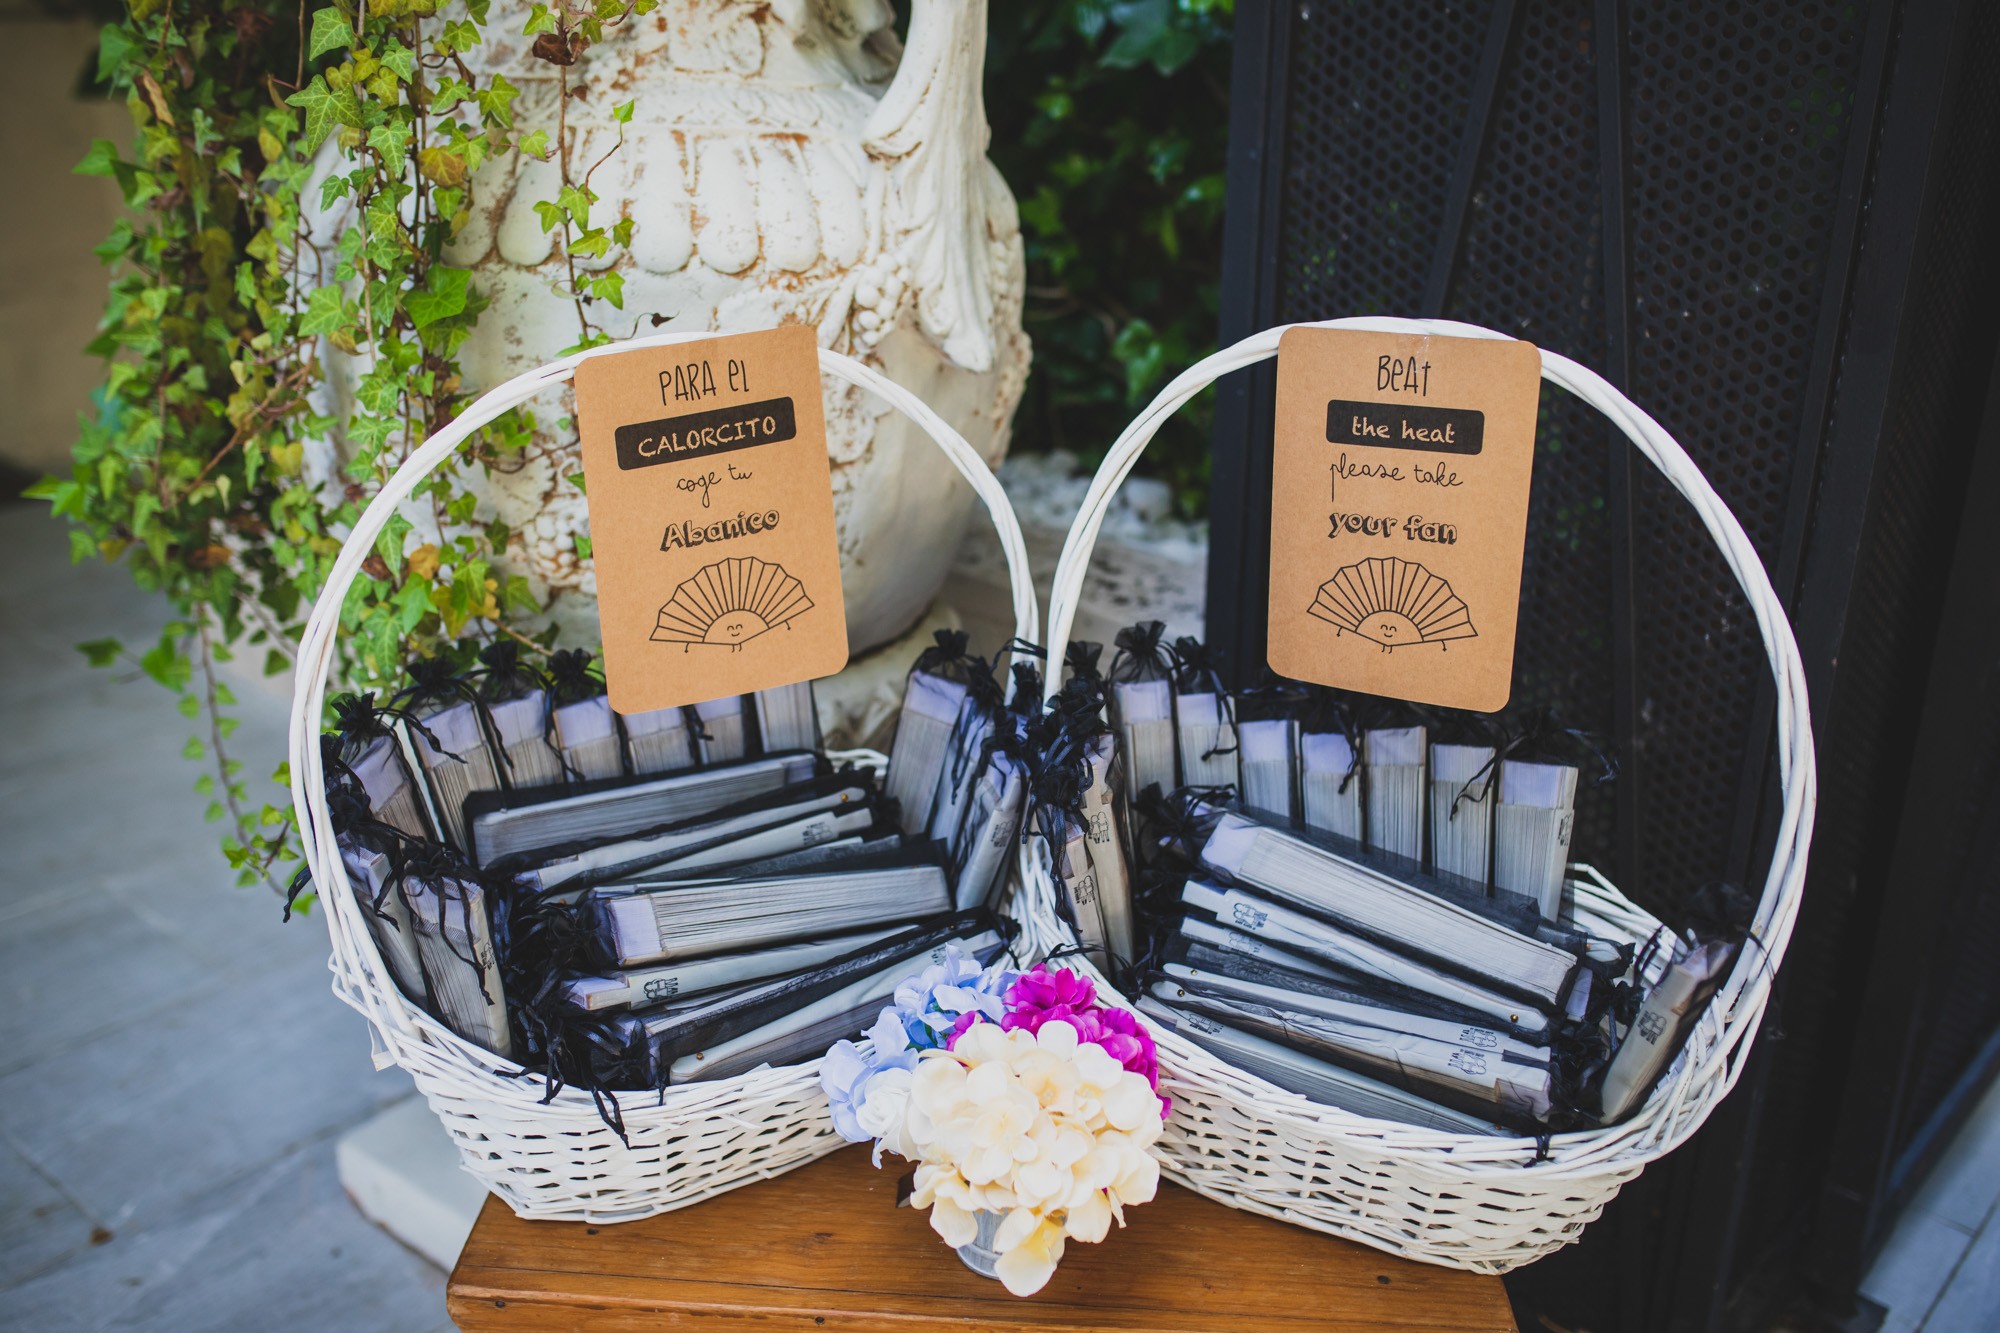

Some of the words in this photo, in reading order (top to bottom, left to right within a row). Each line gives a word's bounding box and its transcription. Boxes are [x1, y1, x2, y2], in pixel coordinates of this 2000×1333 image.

[659, 360, 717, 406] PARA
[637, 415, 777, 458] CALORCITO
[1351, 416, 1390, 439] the
[1402, 420, 1455, 443] heat
[676, 471, 722, 508] coge
[728, 464, 753, 480] tu
[1329, 453, 1406, 502] please
[1414, 462, 1463, 487] take
[660, 509, 780, 552] Abanico
[1328, 512, 1398, 539] your
[1403, 515, 1458, 545] fan
